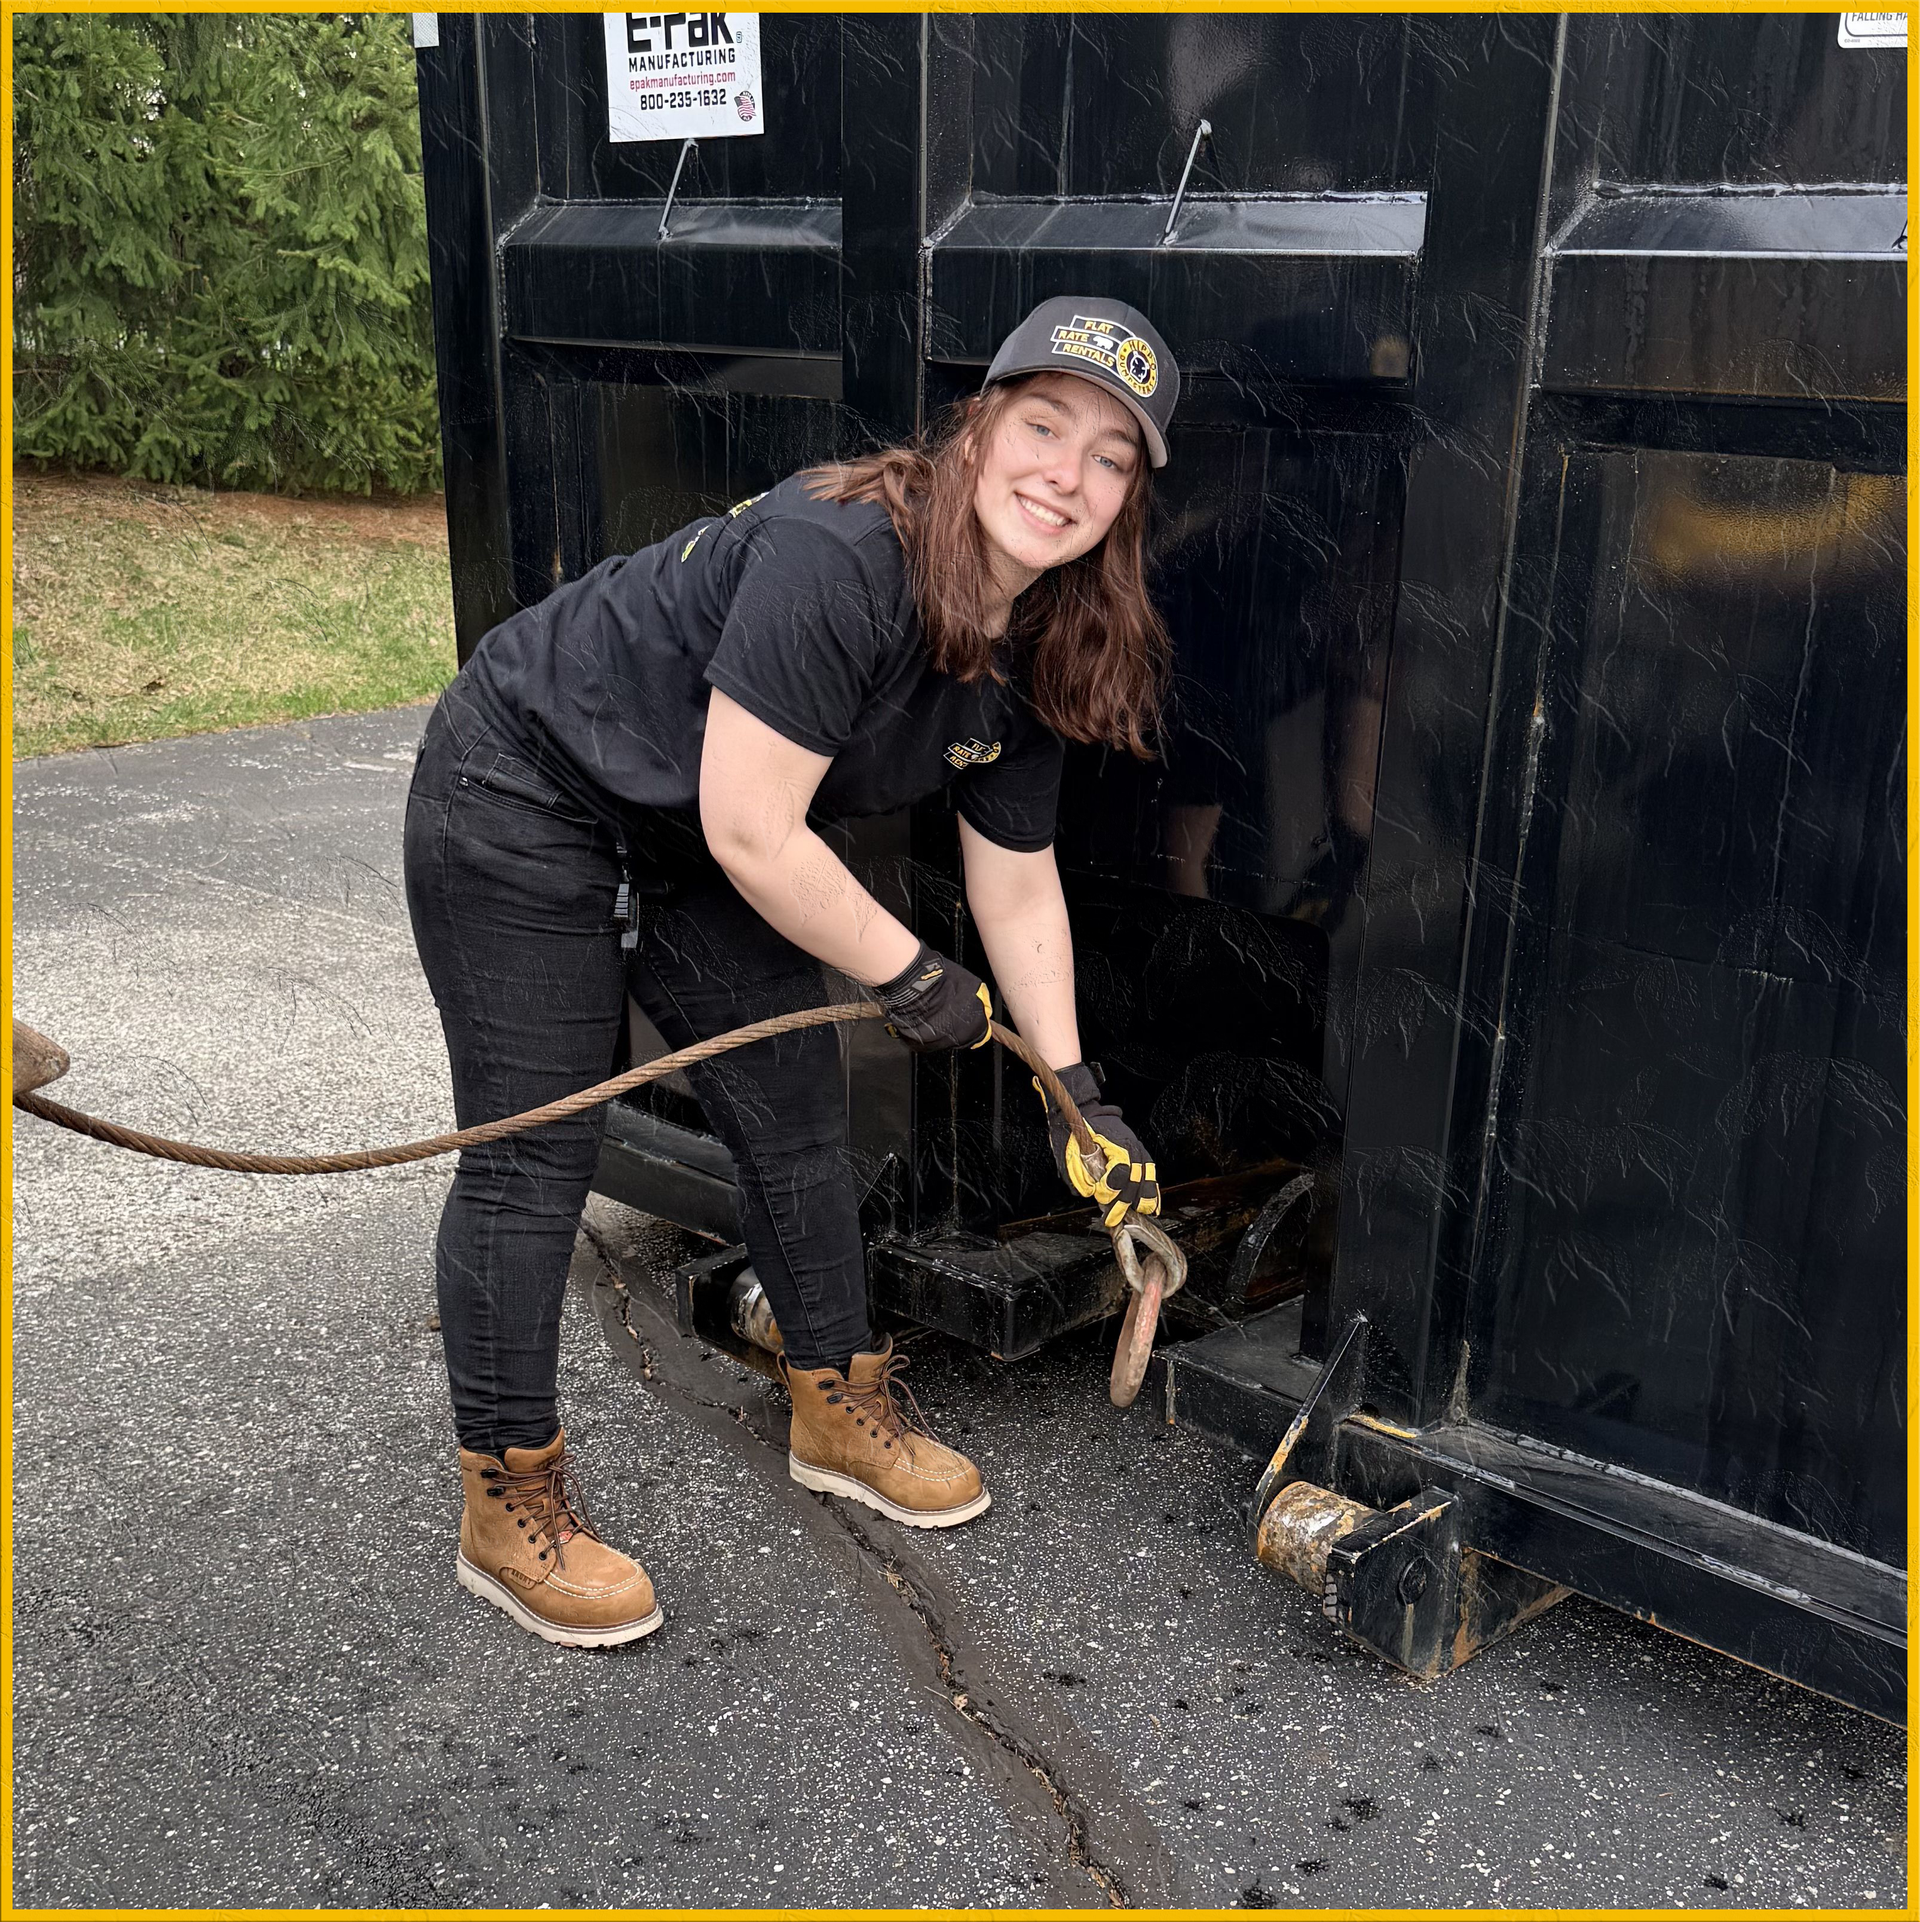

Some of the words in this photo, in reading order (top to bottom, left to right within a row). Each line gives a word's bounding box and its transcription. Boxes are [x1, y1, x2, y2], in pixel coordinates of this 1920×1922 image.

[628, 48, 736, 73] MANUFACTURING
[629, 71, 736, 92] epakmanufacturing.com
[640, 89, 727, 110] 800-235-1632
[1058, 330, 1090, 343] RATE
[1084, 320, 1114, 334] FLAT
[1062, 344, 1116, 367] RENTALS
[1128, 340, 1157, 371] HIPPO
